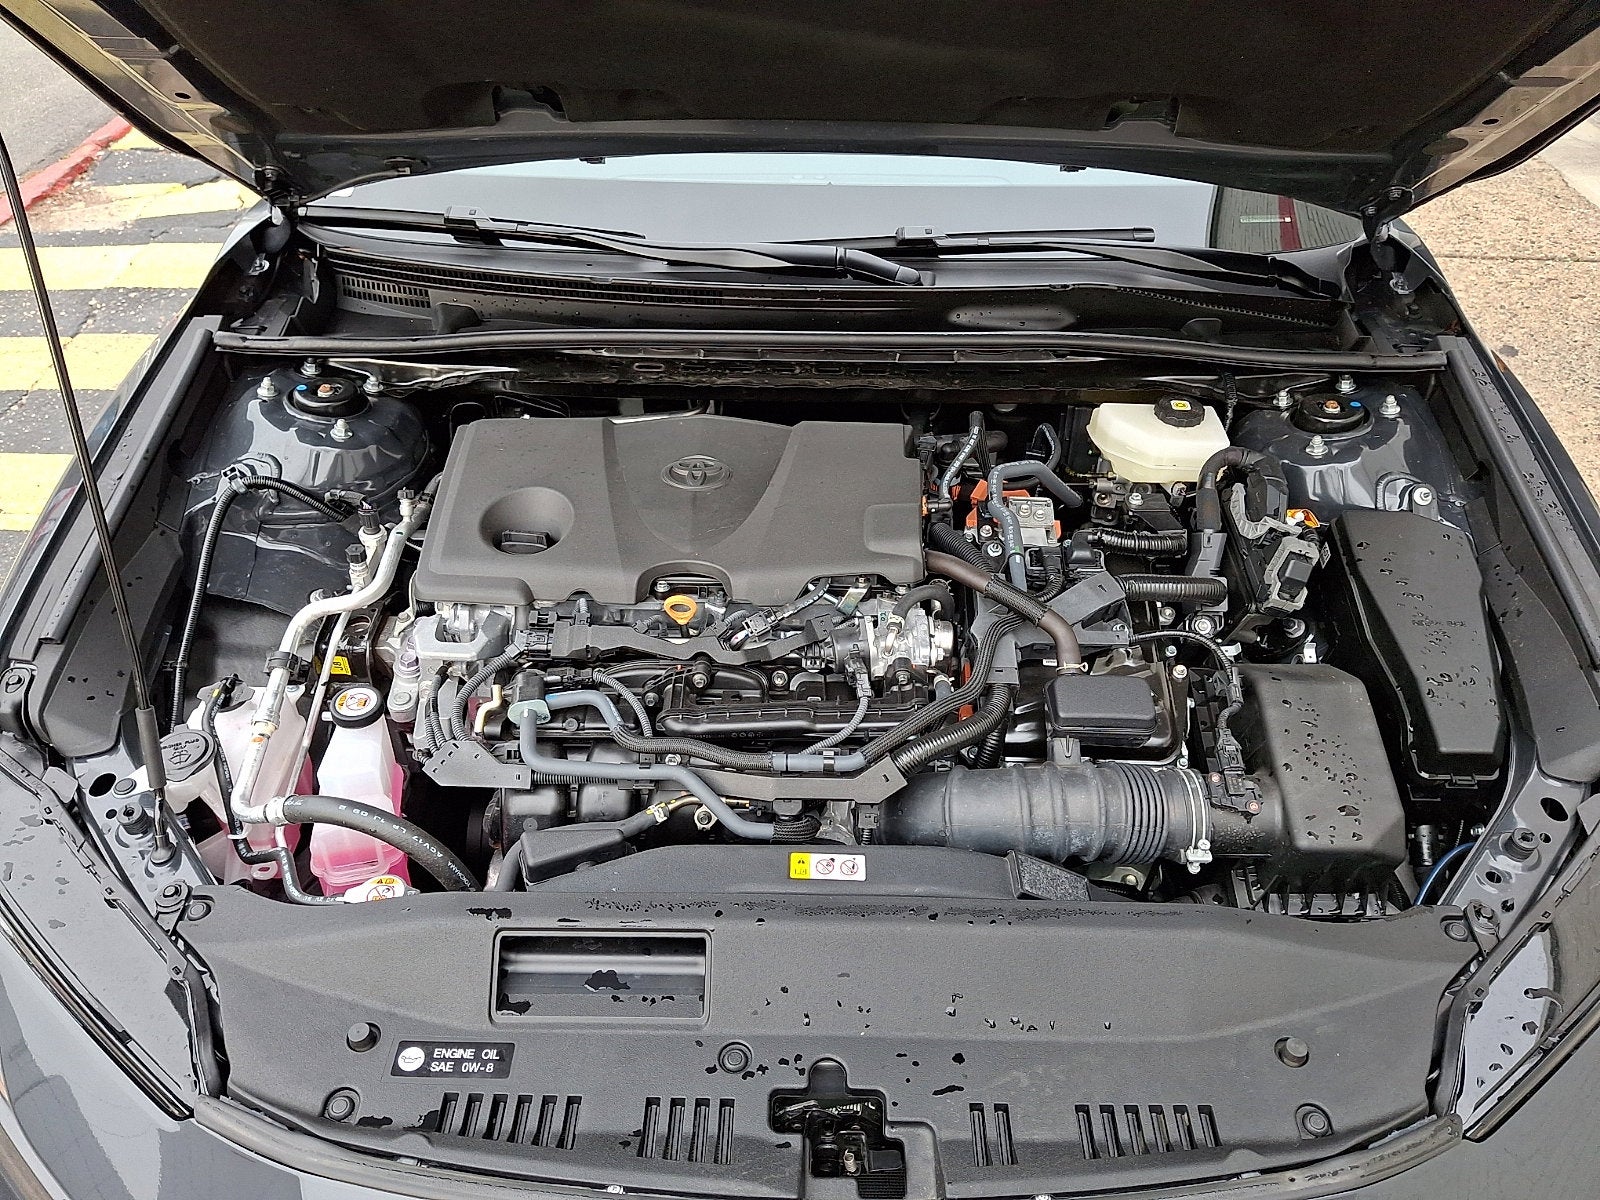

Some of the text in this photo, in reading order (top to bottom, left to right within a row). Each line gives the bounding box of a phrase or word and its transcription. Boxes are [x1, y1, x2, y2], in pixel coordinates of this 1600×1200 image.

[412, 835, 444, 858] ACV17
[433, 1048, 500, 1060] ENGINE OIL
[430, 1062, 494, 1073] SAE 0W-8
